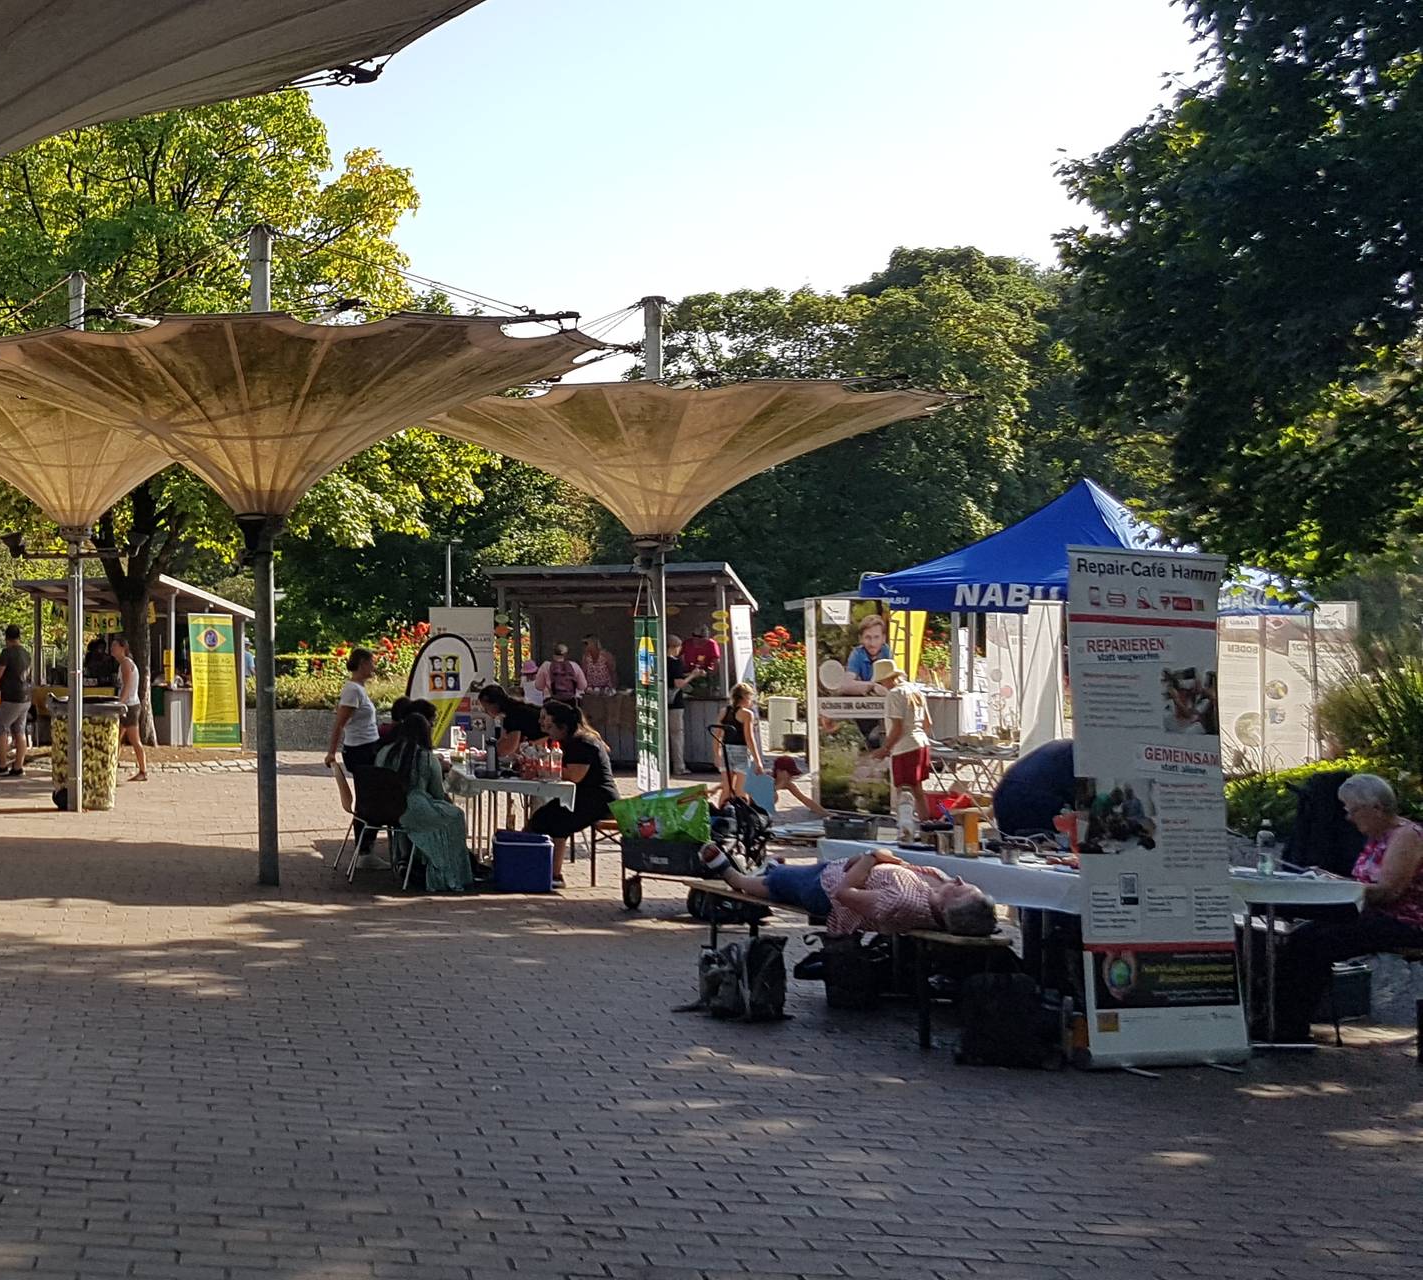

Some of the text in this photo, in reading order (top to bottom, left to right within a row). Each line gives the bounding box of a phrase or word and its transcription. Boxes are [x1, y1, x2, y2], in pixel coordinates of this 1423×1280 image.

[1077, 558, 1217, 582] Repair-Café Hamm
[1087, 638, 1165, 653] REPARIEREN
